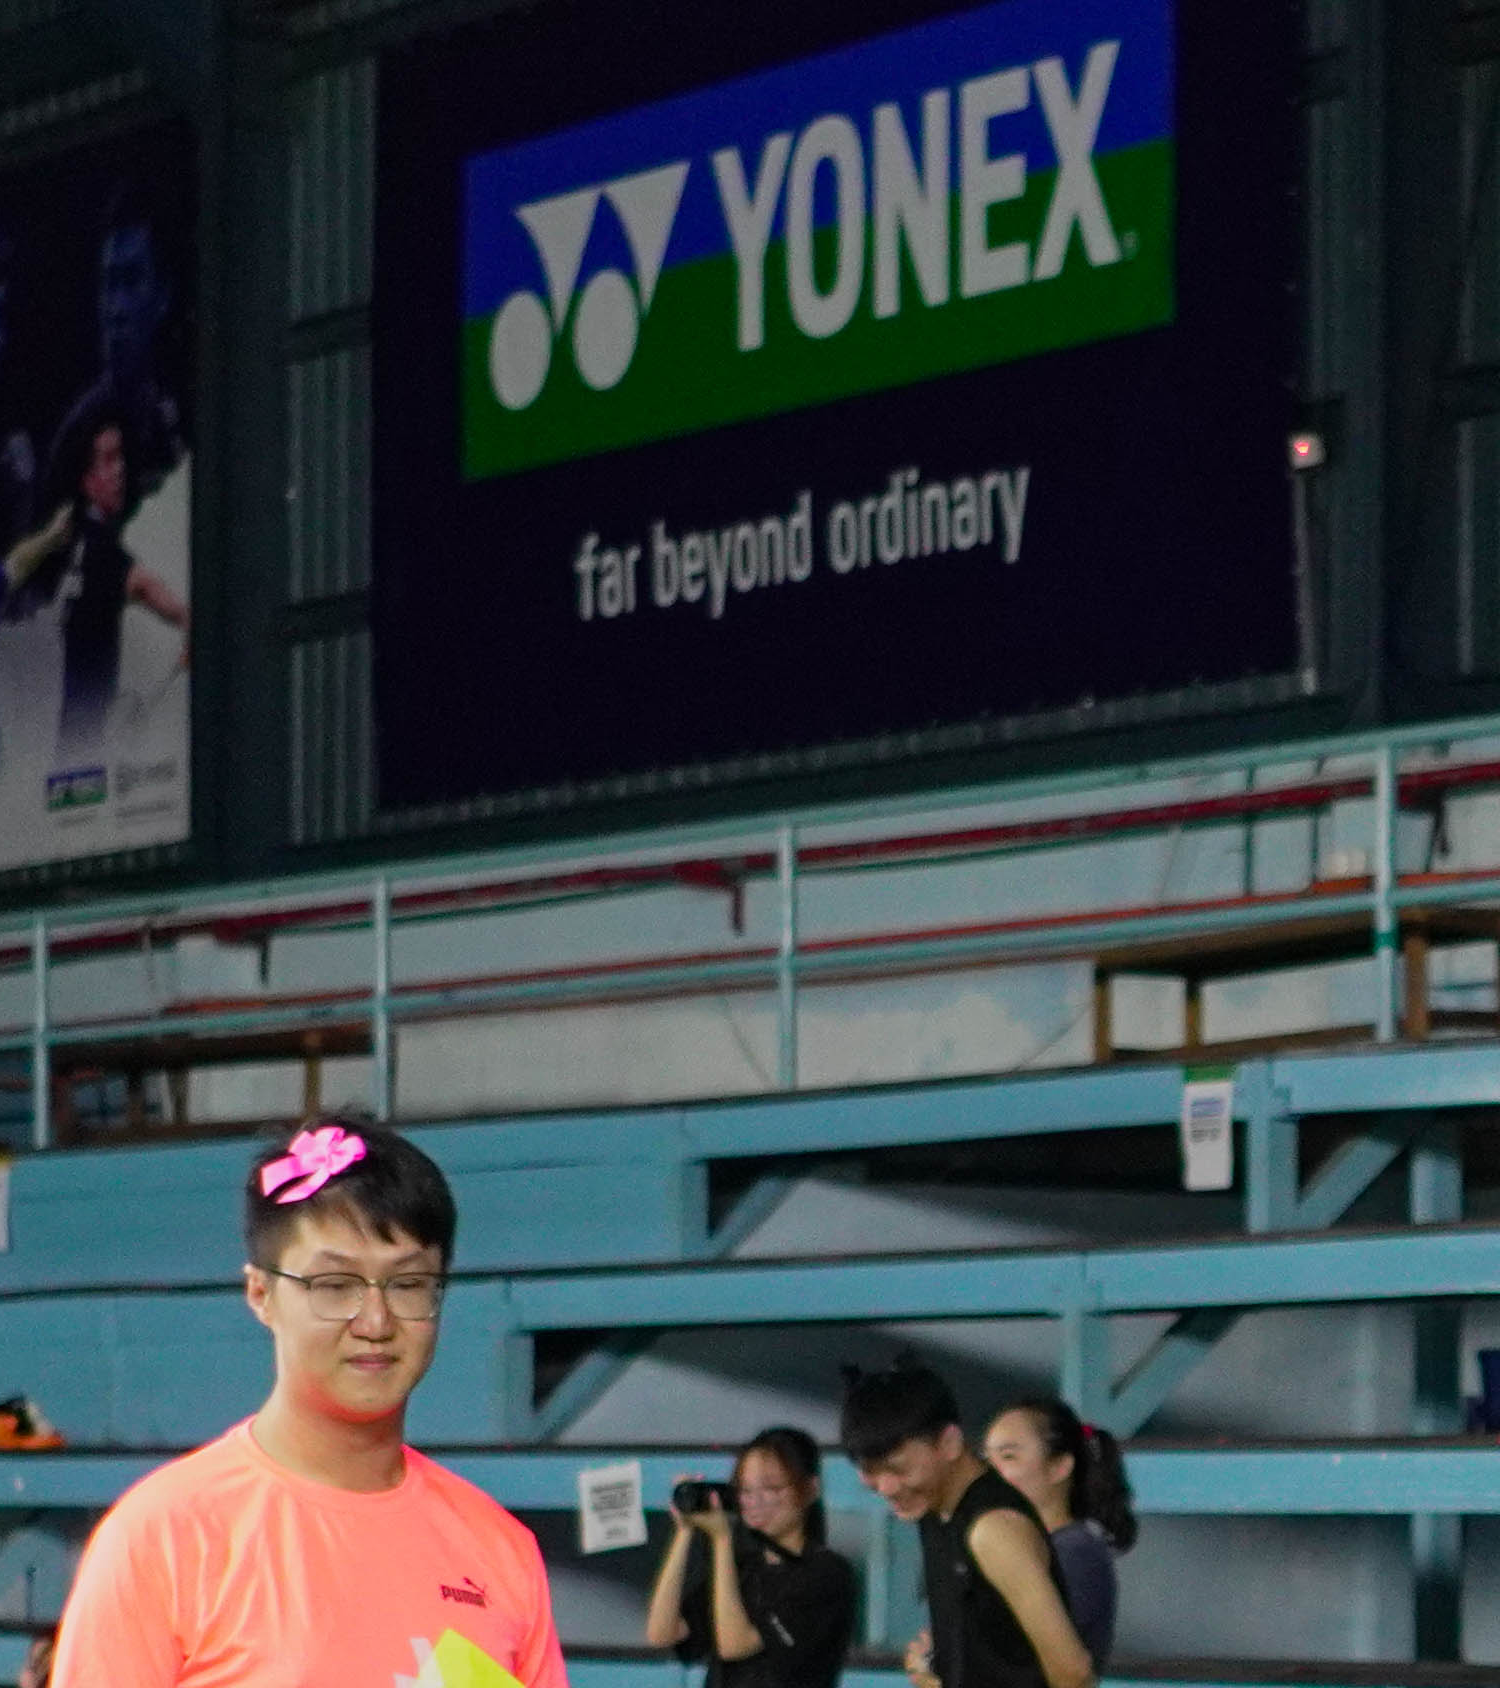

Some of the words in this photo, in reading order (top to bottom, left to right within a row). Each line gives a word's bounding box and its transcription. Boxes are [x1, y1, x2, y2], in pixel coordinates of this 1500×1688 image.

[712, 38, 1122, 353] YONEX
[574, 532, 641, 622] far
[650, 489, 813, 621] beyond
[827, 464, 1032, 574] ordinary
